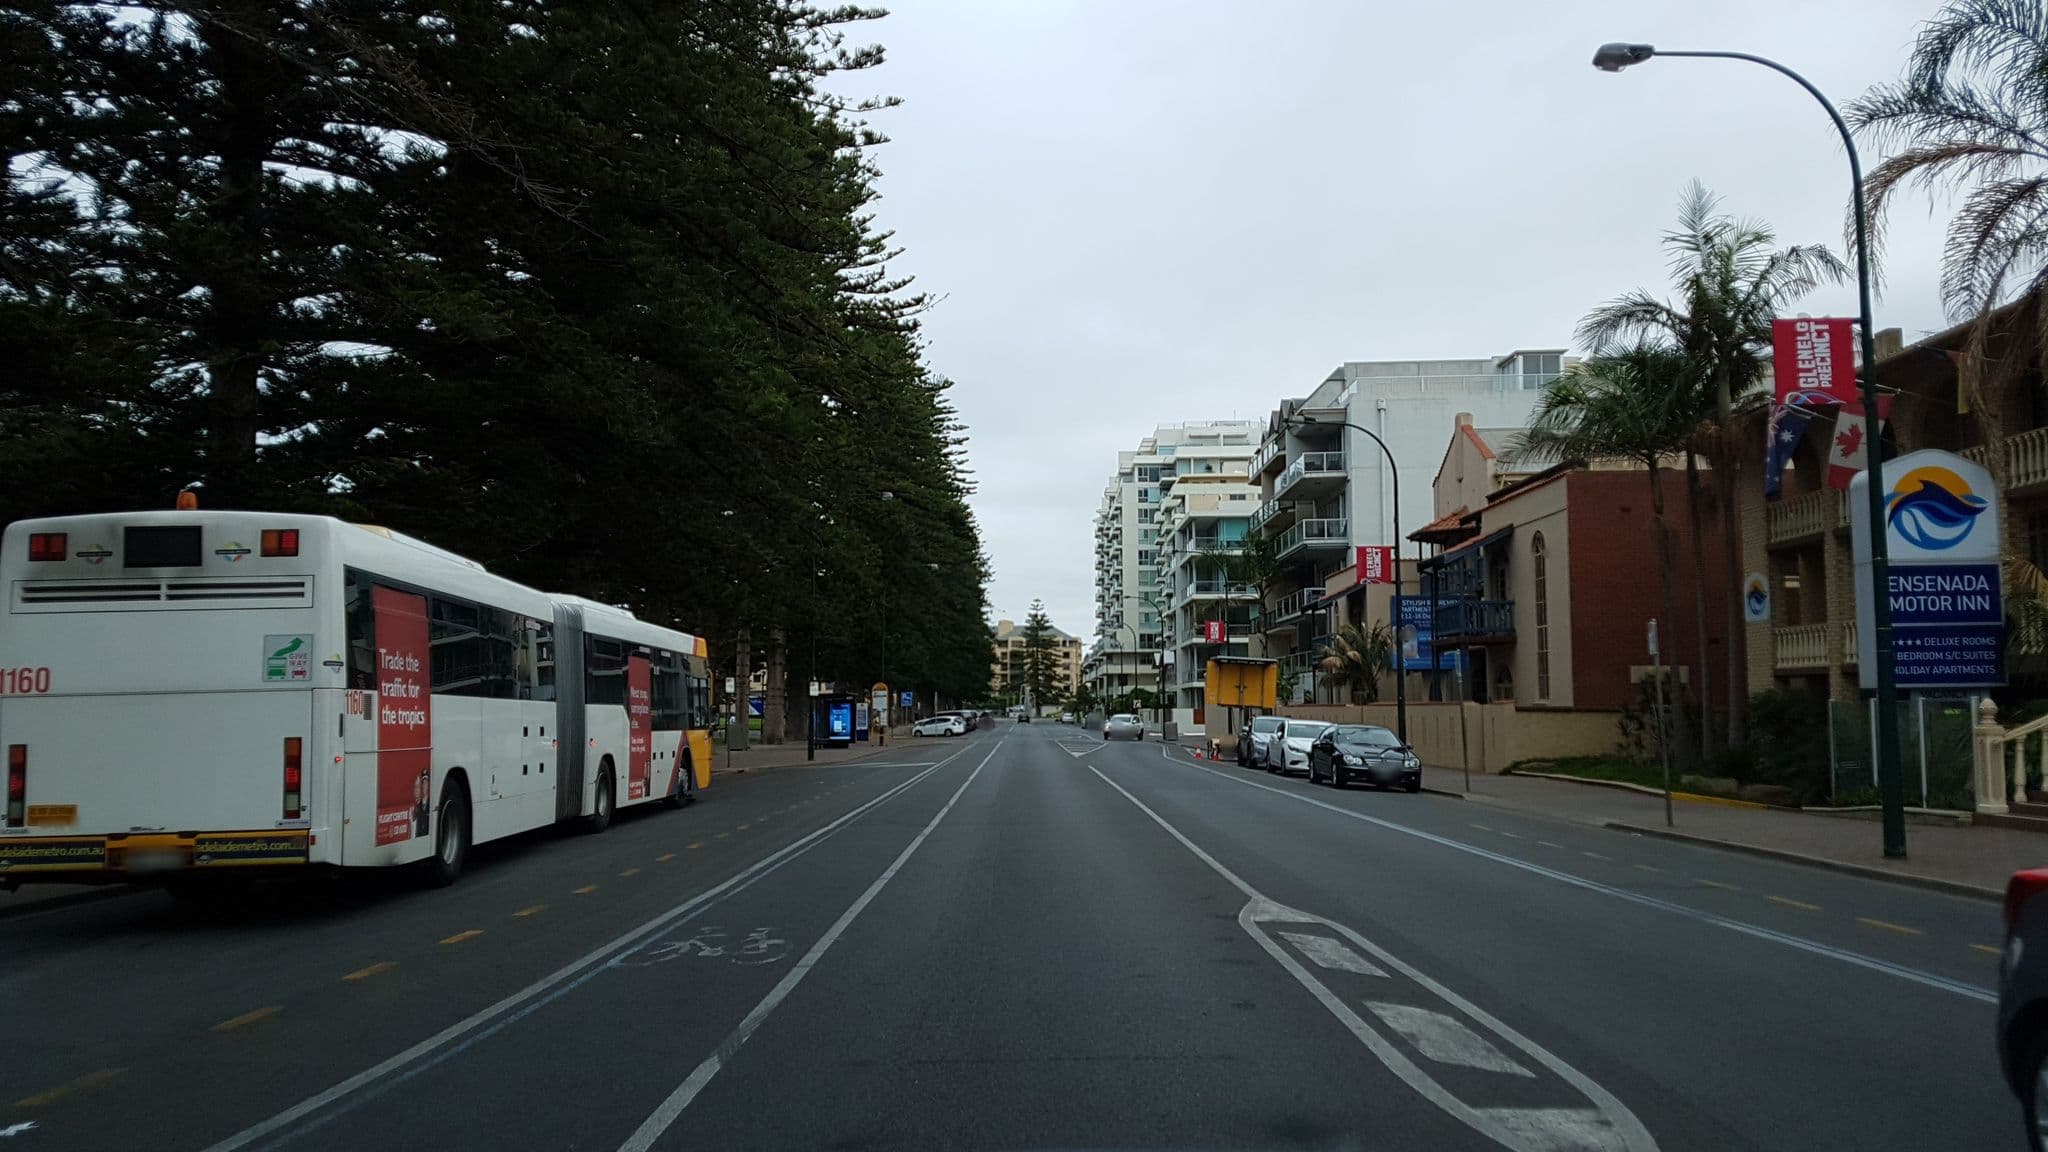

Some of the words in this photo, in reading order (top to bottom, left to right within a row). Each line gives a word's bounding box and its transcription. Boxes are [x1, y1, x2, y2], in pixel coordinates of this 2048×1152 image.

[1796, 322, 1819, 388] GLENELG
[1810, 322, 1832, 388] PRECINCT
[1888, 575, 1989, 592] ENSENADA
[1890, 595, 1952, 612] MOTOR
[1957, 595, 1990, 611] INN
[1924, 637, 1959, 646] DELUXE
[1963, 637, 1996, 646] ROOMS
[379, 648, 404, 670] Trade
[405, 652, 419, 672] the
[1897, 651, 1943, 661] BEDROOM
[1945, 651, 1961, 660] S/C
[1963, 651, 1996, 660] SUITES
[1932, 665, 1996, 674] APARTMENTS
[0, 667, 50, 693] 1160
[382, 678, 406, 697] traffic
[408, 679, 420, 698] for
[345, 691, 363, 714] 1160
[382, 704, 396, 724] the
[398, 707, 425, 731] tropics
[0, 846, 105, 858] delaidemetro.com.au
